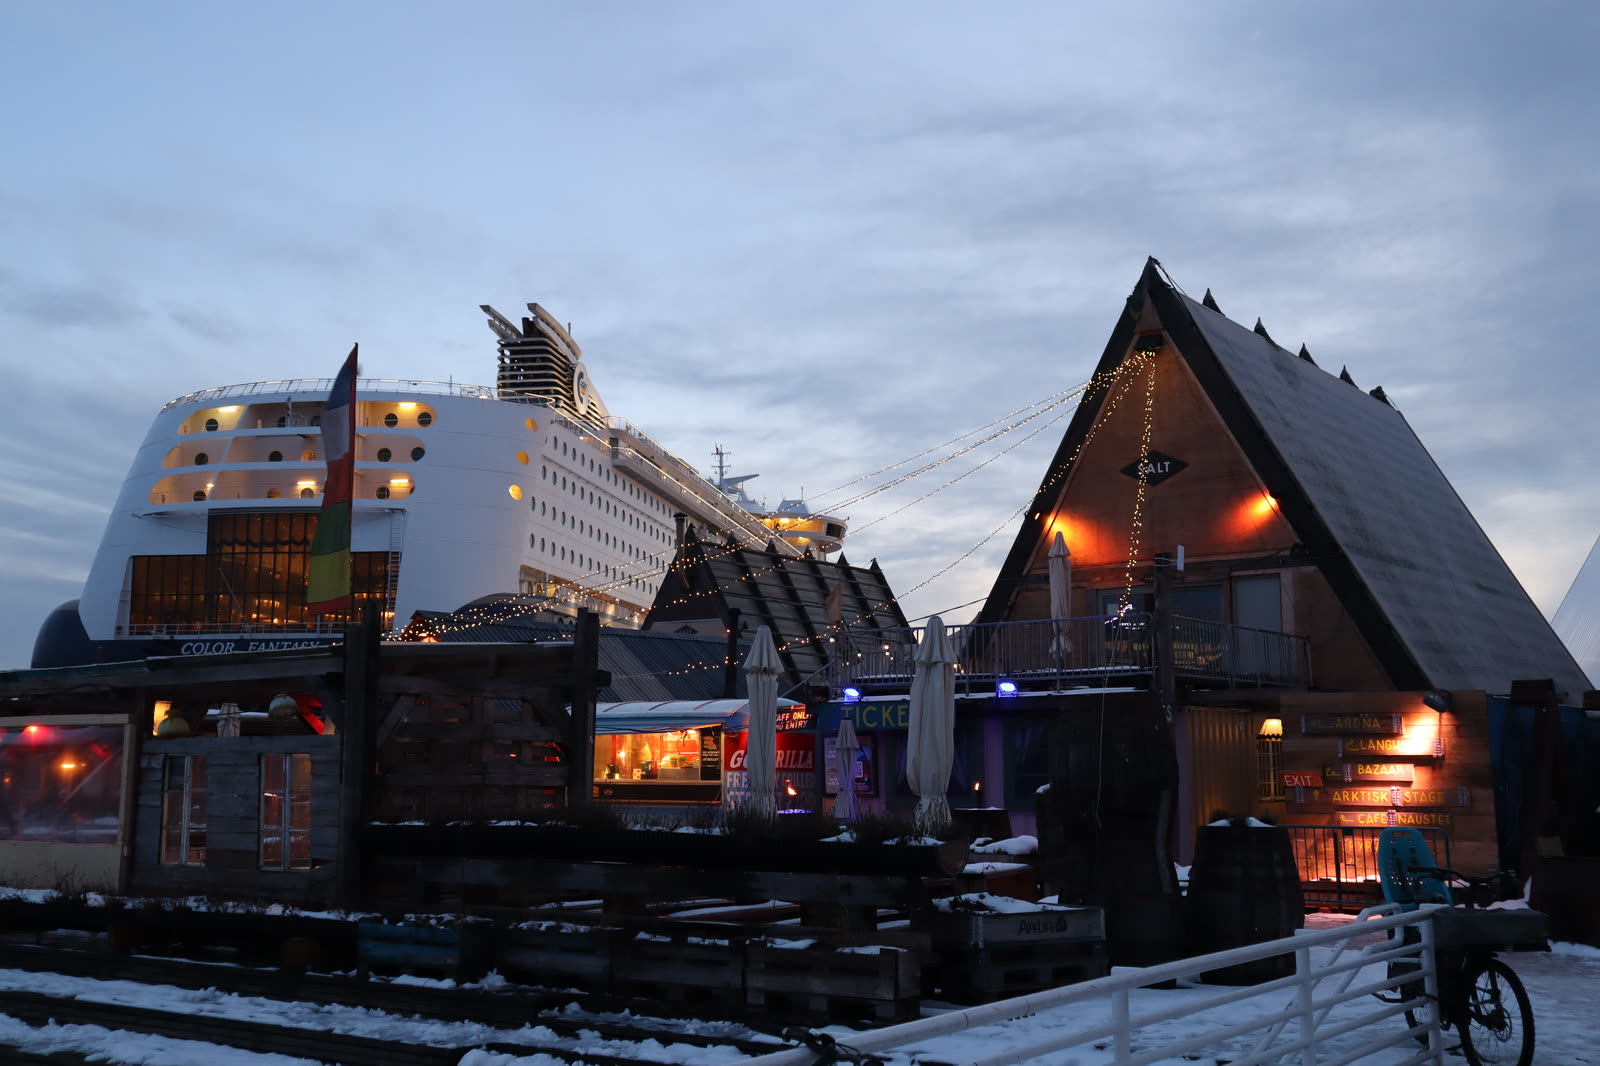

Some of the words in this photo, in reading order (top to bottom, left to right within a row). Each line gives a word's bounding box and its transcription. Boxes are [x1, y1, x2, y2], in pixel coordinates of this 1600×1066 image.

[1138, 461, 1170, 474] SALT
[180, 641, 235, 655] COLOR
[776, 713, 790, 722] AFF
[840, 704, 909, 728] TICKE
[1357, 763, 1405, 775] BAZAAR
[1283, 775, 1312, 787] EXIT
[1332, 790, 1389, 802] ARKTISK
[1403, 790, 1446, 803] STAGE
[1357, 813, 1387, 824] CAFE
